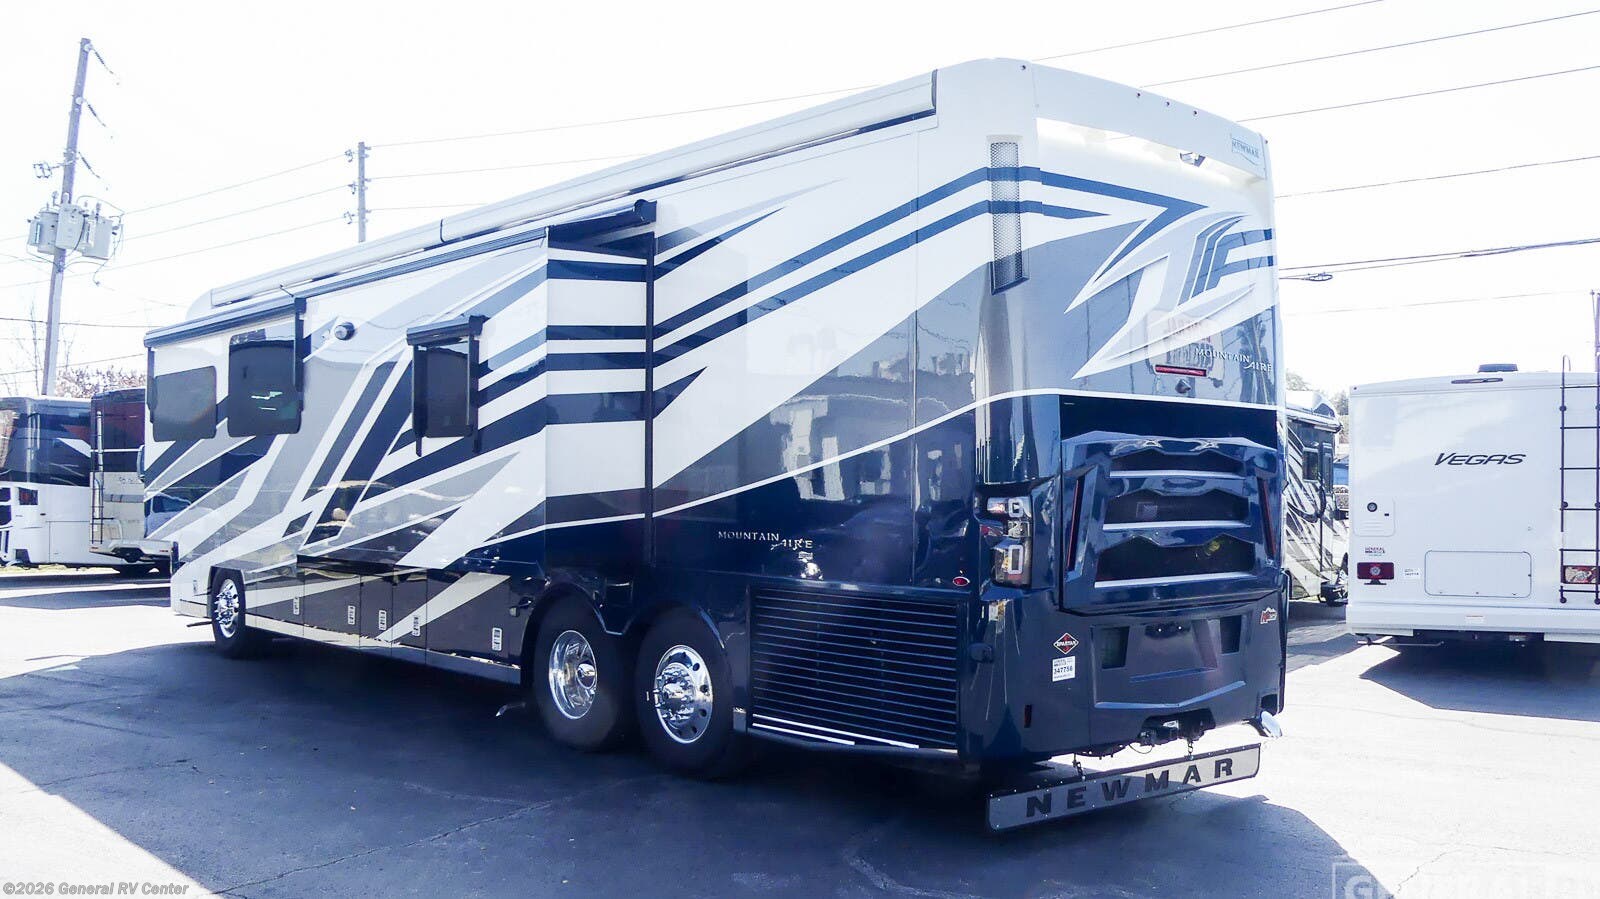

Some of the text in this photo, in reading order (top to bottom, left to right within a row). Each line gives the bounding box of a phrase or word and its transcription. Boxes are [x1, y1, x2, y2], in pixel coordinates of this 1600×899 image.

[1231, 139, 1260, 158] NEWMAR
[1194, 347, 1251, 363] MOUNTAIN
[1244, 361, 1273, 372] AIRE
[1434, 452, 1527, 466] VEGAS
[718, 530, 780, 541] MOUNTAIN
[770, 538, 814, 551] AIRE
[1026, 757, 1234, 818] NEWMAR
